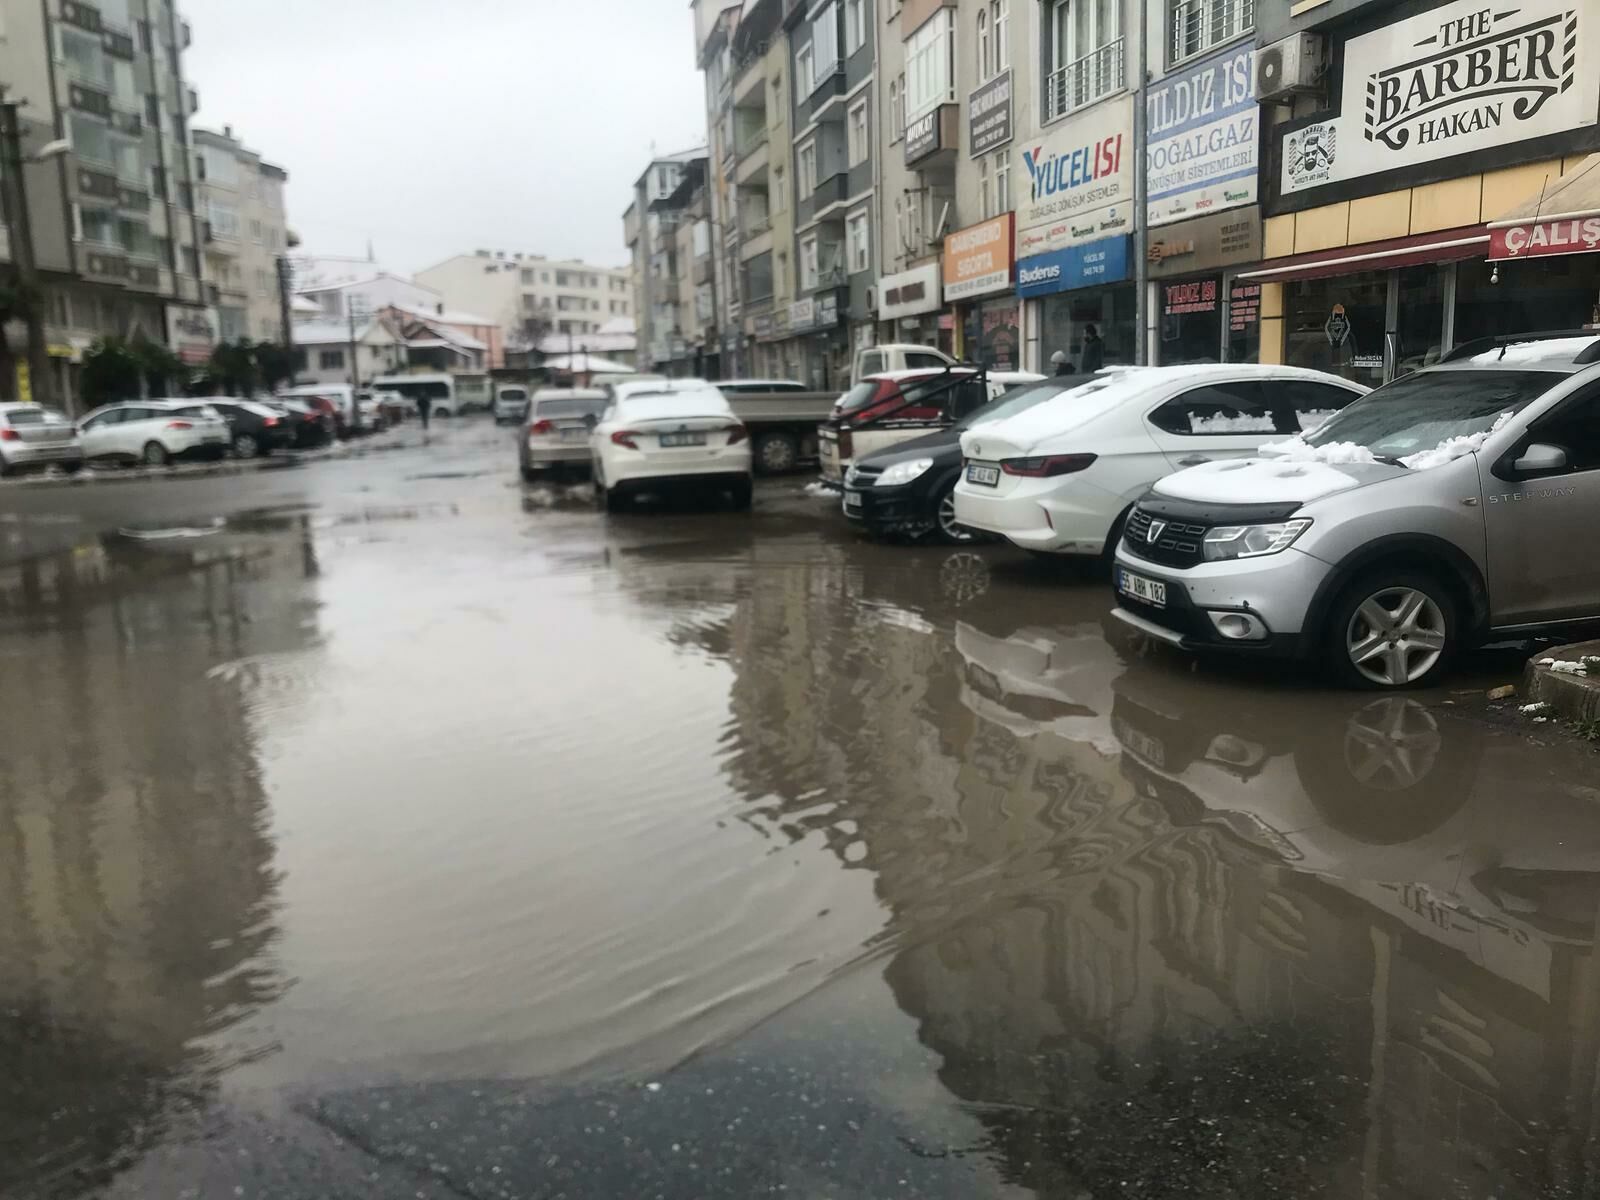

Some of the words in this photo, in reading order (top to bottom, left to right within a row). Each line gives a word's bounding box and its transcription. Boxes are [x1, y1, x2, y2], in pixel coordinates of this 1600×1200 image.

[1440, 8, 1491, 49] THE
[1376, 29, 1560, 127] BARBER
[1417, 102, 1503, 146] HAKAN
[1147, 168, 1185, 194] ÖNÜŞÜM
[1188, 145, 1253, 182] SİSTEMLERİ
[1019, 265, 1060, 284] Buderus
[1165, 282, 1200, 305] YILDIZ
[1201, 281, 1216, 301] ISI
[1489, 487, 1577, 504] STEPWAY
[1149, 582, 1165, 602] 182
